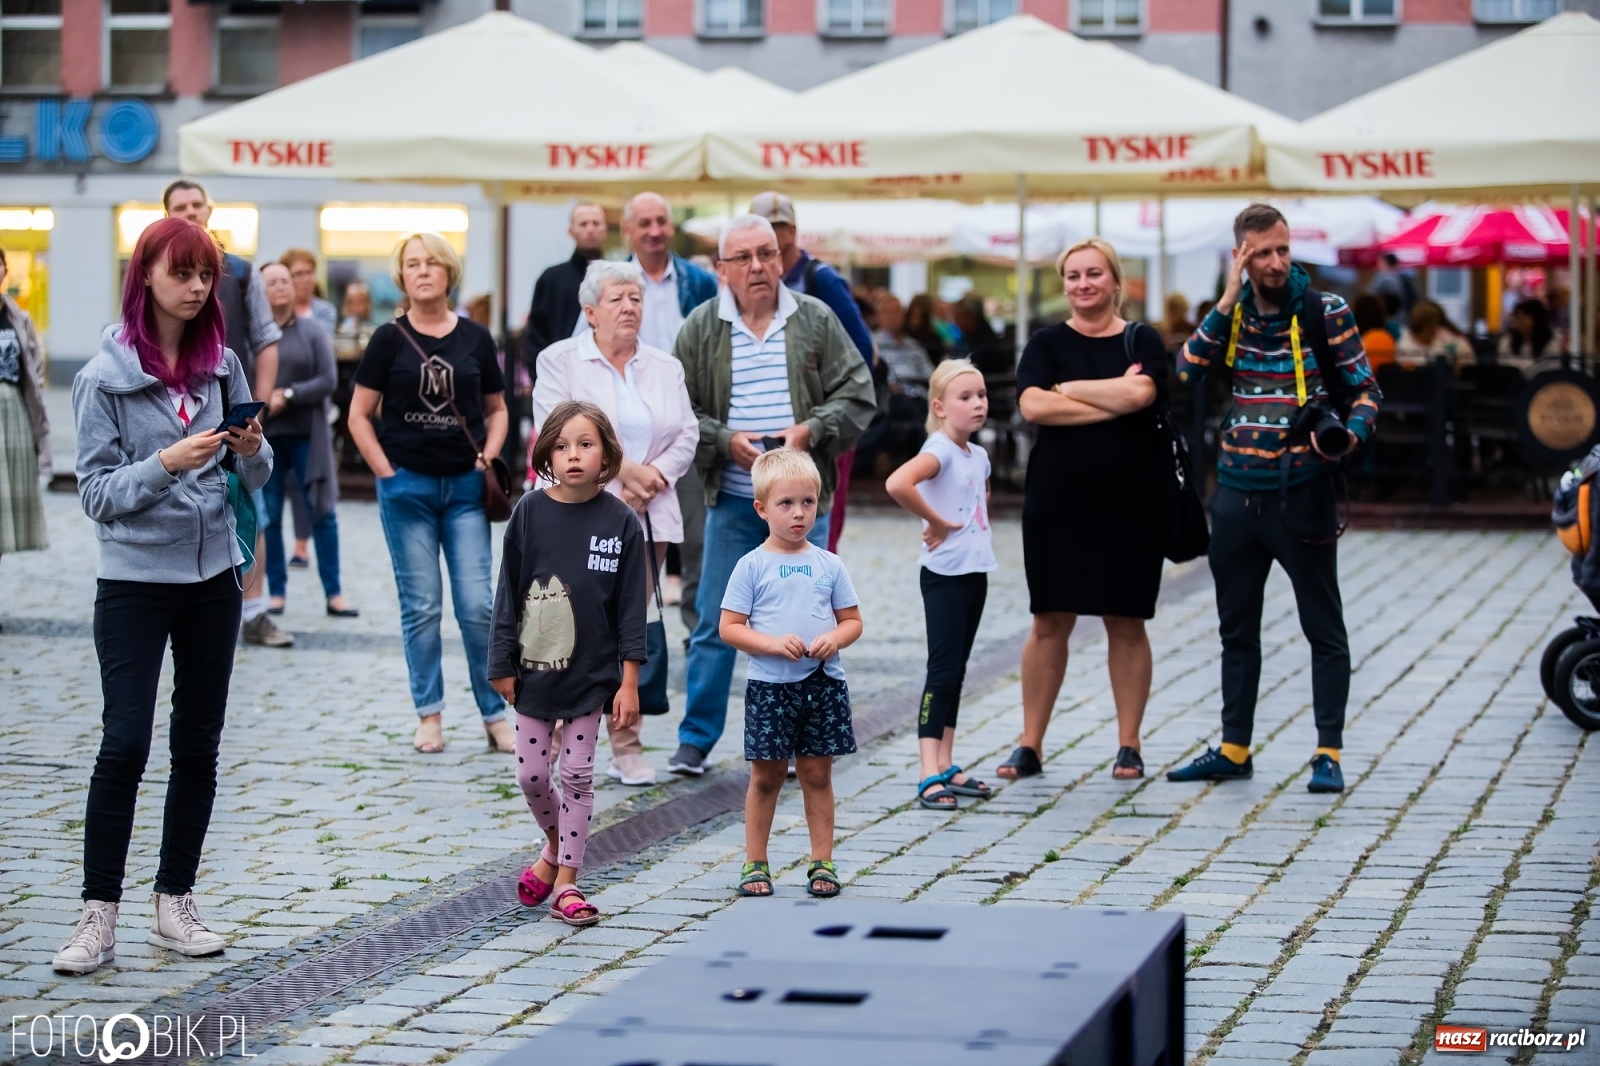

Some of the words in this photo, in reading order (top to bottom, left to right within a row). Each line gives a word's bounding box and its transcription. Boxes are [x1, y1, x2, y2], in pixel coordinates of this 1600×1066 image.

[228, 139, 334, 167] TYSKIE
[547, 142, 653, 170] TYSKIE
[760, 139, 866, 168] TYSKIE
[1083, 134, 1195, 162] TYSKIE
[1317, 148, 1435, 179] TYSKIE
[589, 535, 623, 555] Let's
[587, 553, 619, 573] Hug
